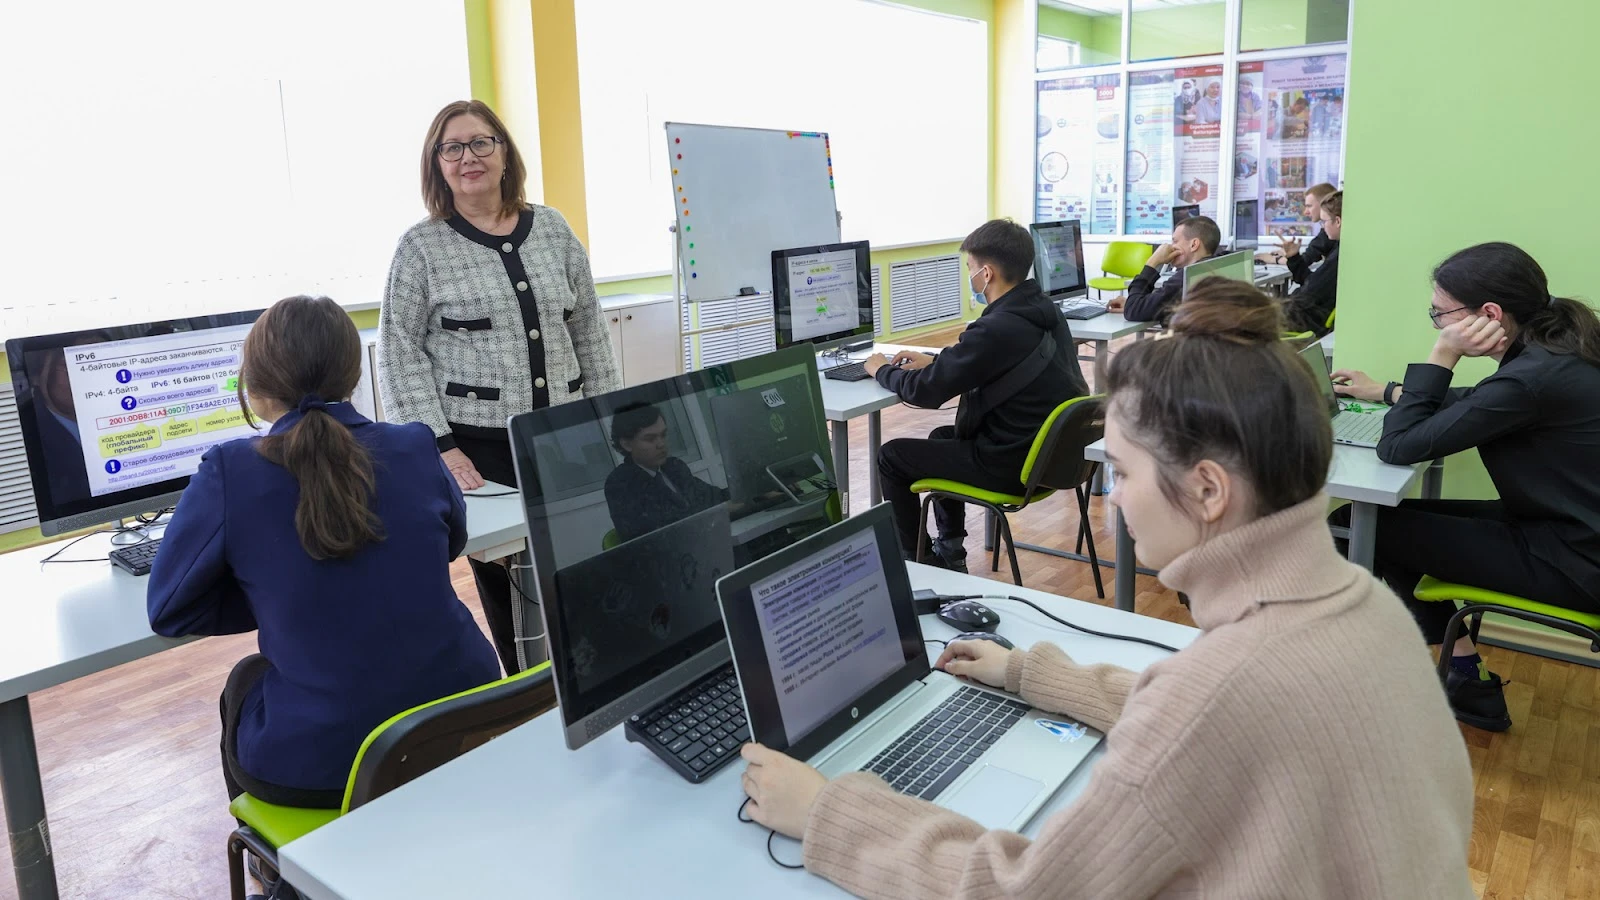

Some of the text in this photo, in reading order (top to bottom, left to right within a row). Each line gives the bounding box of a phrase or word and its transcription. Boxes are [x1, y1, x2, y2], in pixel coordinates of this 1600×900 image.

[74, 352, 95, 361] IPv6
[79, 360, 127, 372] 4-байтовые
[128, 355, 167, 366] IP-адреса
[132, 357, 235, 378] Нужно увеличить длину адреса!
[150, 379, 170, 388] IPv6:
[172, 377, 182, 385] 16
[182, 372, 210, 383] байтов
[211, 370, 227, 379] (128
[84, 384, 138, 399] IPv4: 4-байта
[138, 385, 215, 405] Сколько всего адресов?
[168, 421, 188, 430] адрес
[205, 418, 225, 427] номер
[225, 414, 241, 423] узла
[101, 428, 155, 444] код провайдера
[166, 427, 193, 438] подсети
[105, 435, 153, 450] (глобальный
[113, 442, 149, 454] префикс)
[122, 457, 148, 469] Старое
[148, 447, 195, 463] оборудование
[758, 587, 769, 598] Что
[770, 579, 786, 591] такое
[787, 563, 821, 583] электронная
[821, 546, 852, 566] коммерция?
